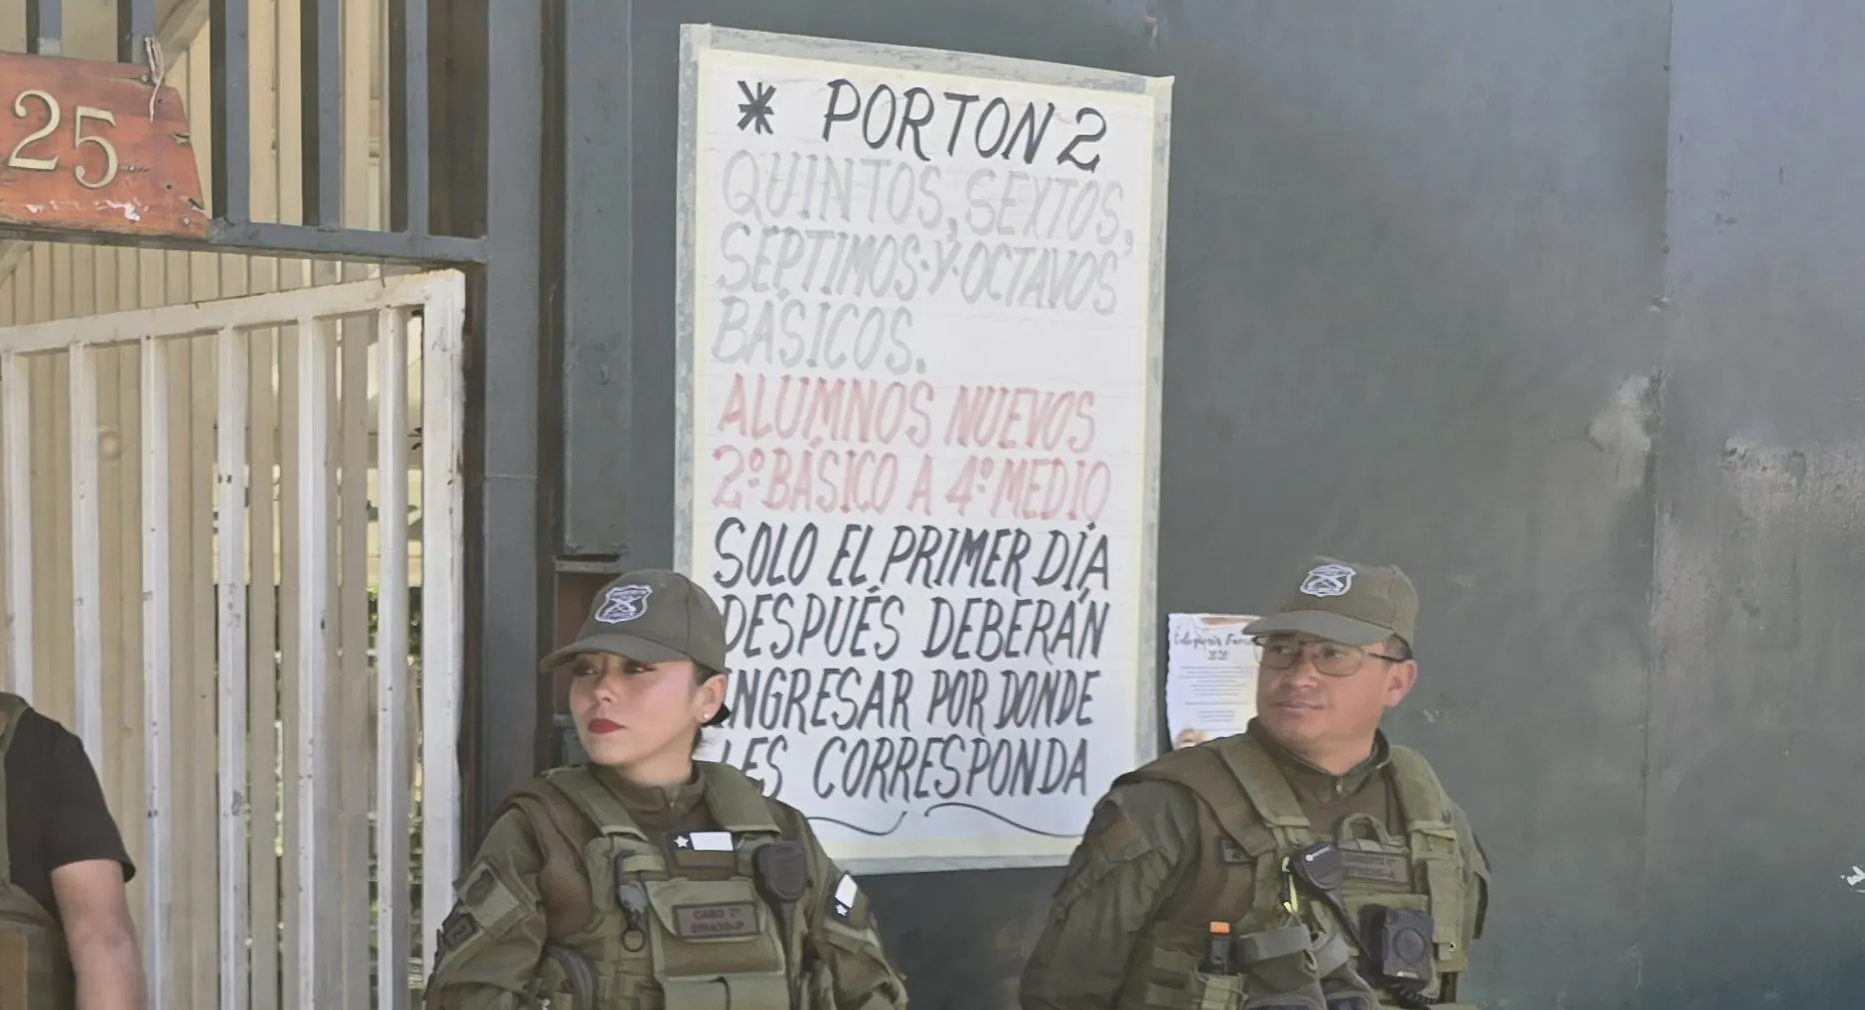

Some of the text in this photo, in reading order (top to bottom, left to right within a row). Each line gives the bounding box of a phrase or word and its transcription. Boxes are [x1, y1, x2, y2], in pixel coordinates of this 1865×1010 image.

[821, 78, 1108, 174] PORTON 2
[722, 147, 1135, 256] QUINTOS, SEXTOS,
[959, 241, 1118, 316] OCTAVOS
[716, 371, 1097, 454] ALUMNOS NUEVOS
[905, 452, 933, 517] A
[990, 457, 1112, 522] MEDIO
[712, 516, 1111, 596] SOLO EL PRIMER DÍA
[722, 585, 1111, 666] DESPUÉS DEBERÁN
[719, 666, 914, 735] NGRESAR
[926, 668, 989, 737] POR
[992, 669, 1102, 729] DONDE
[812, 733, 1089, 801] CORRESPONDA
